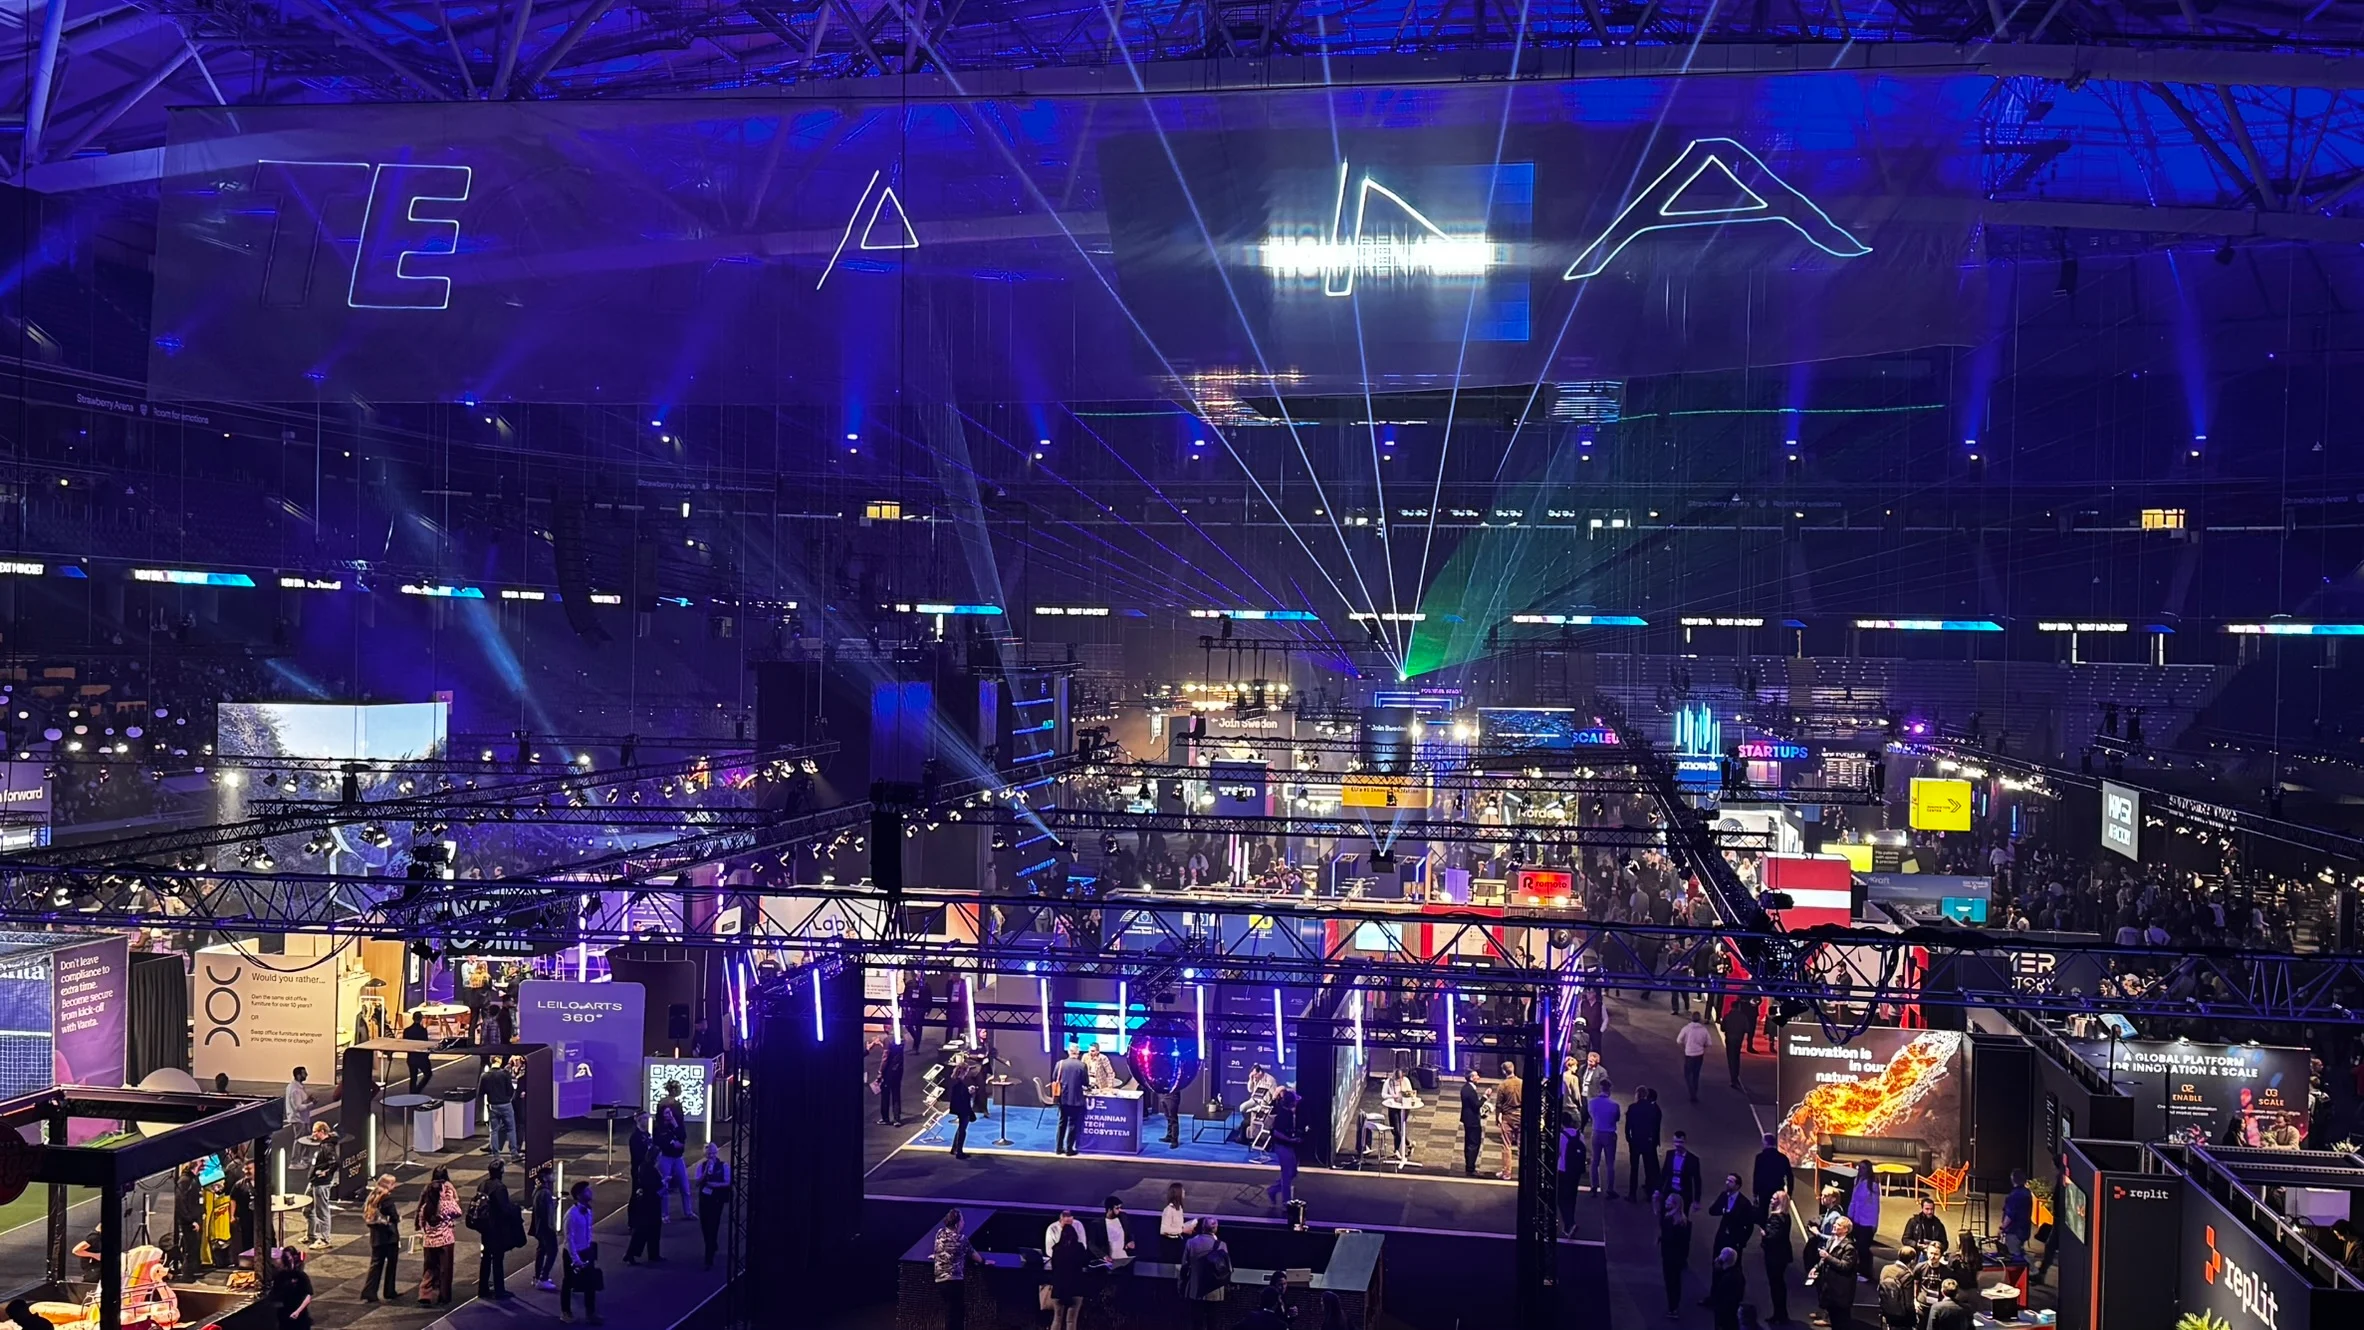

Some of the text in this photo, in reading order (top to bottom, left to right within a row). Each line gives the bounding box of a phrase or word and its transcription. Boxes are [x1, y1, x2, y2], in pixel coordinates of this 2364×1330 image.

[1564, 137, 1873, 280] A
[76, 393, 114, 411] Strawberry
[114, 400, 134, 412] Arena
[153, 407, 171, 418] Room
[171, 410, 181, 420] for
[637, 478, 674, 490] Strawberry
[675, 480, 696, 490] Arena
[1218, 718, 1278, 729] Join Sweden
[1738, 745, 1808, 759] STARTUPS
[4, 786, 43, 803] forward
[60, 956, 100, 971] Don't leave
[60, 965, 111, 983] compliance to
[251, 972, 326, 984] Would you rather...
[60, 981, 98, 996] extra time.
[61, 989, 114, 1008] Become secure
[61, 1002, 105, 1021] from kick-off
[61, 1018, 99, 1034] with Vanta.
[1789, 1043, 1873, 1060] Innovation is
[1848, 1060, 1887, 1072] in our
[2123, 1052, 2245, 1067] A GLOBAL PLATFORM
[2209, 1066, 2218, 1075] &
[2221, 1067, 2259, 1078] SCALE
[2181, 1084, 2279, 1097] 02 03
[2172, 1094, 2285, 1107] ENABLE SCALE
[1084, 1120, 1105, 1128] TECH
[1083, 1127, 1130, 1137] ECOSYSTEM
[2129, 1188, 2169, 1200] replit
[2224, 1256, 2279, 1330] replit
